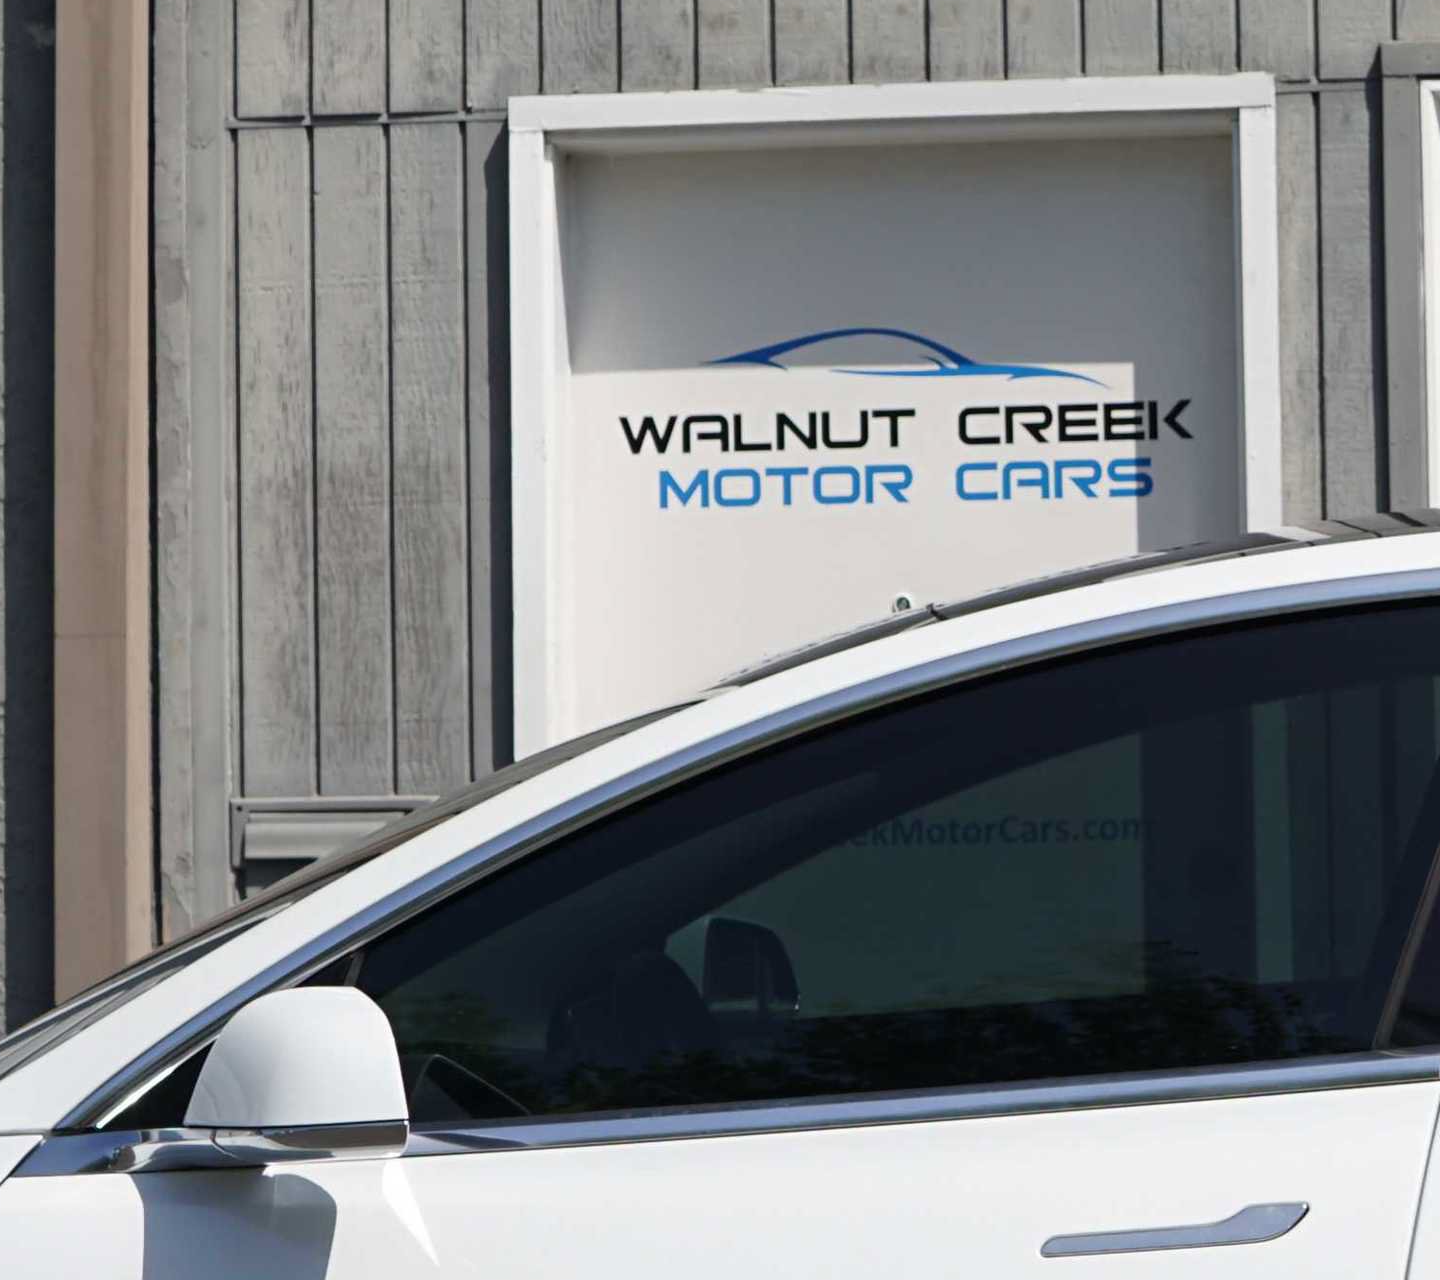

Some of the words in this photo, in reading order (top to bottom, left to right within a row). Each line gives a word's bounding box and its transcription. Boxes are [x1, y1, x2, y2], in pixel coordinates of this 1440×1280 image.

[619, 408, 916, 455] WALNUT
[958, 398, 1194, 446] CREEK
[658, 463, 914, 510] MOTOR
[954, 456, 1154, 503] CARS
